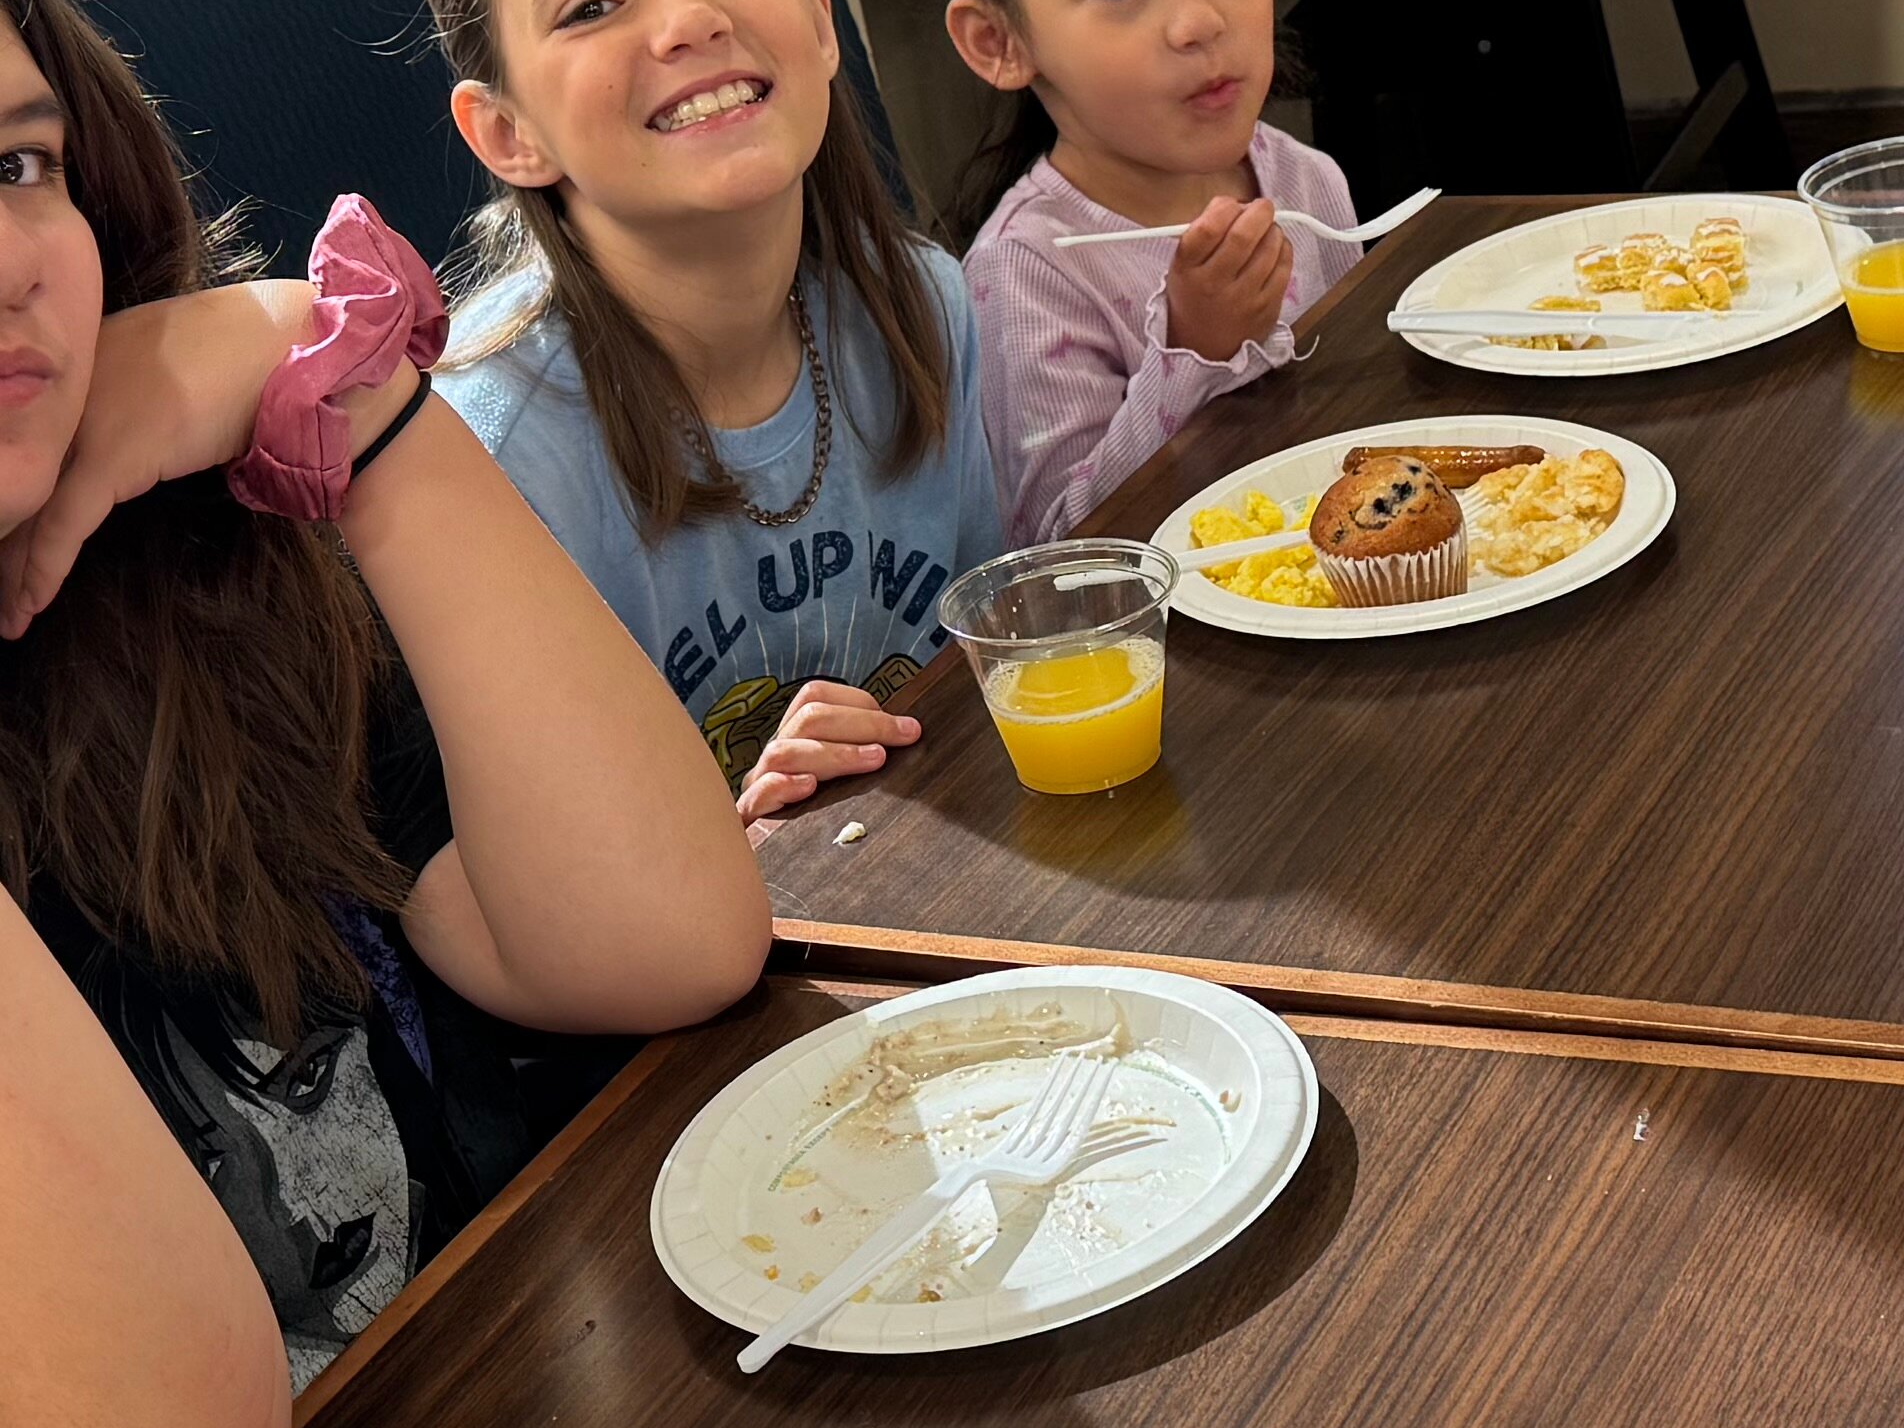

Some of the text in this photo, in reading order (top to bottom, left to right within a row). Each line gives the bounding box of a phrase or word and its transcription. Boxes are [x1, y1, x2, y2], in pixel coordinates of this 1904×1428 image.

[664, 529, 950, 704] EL UP WI
